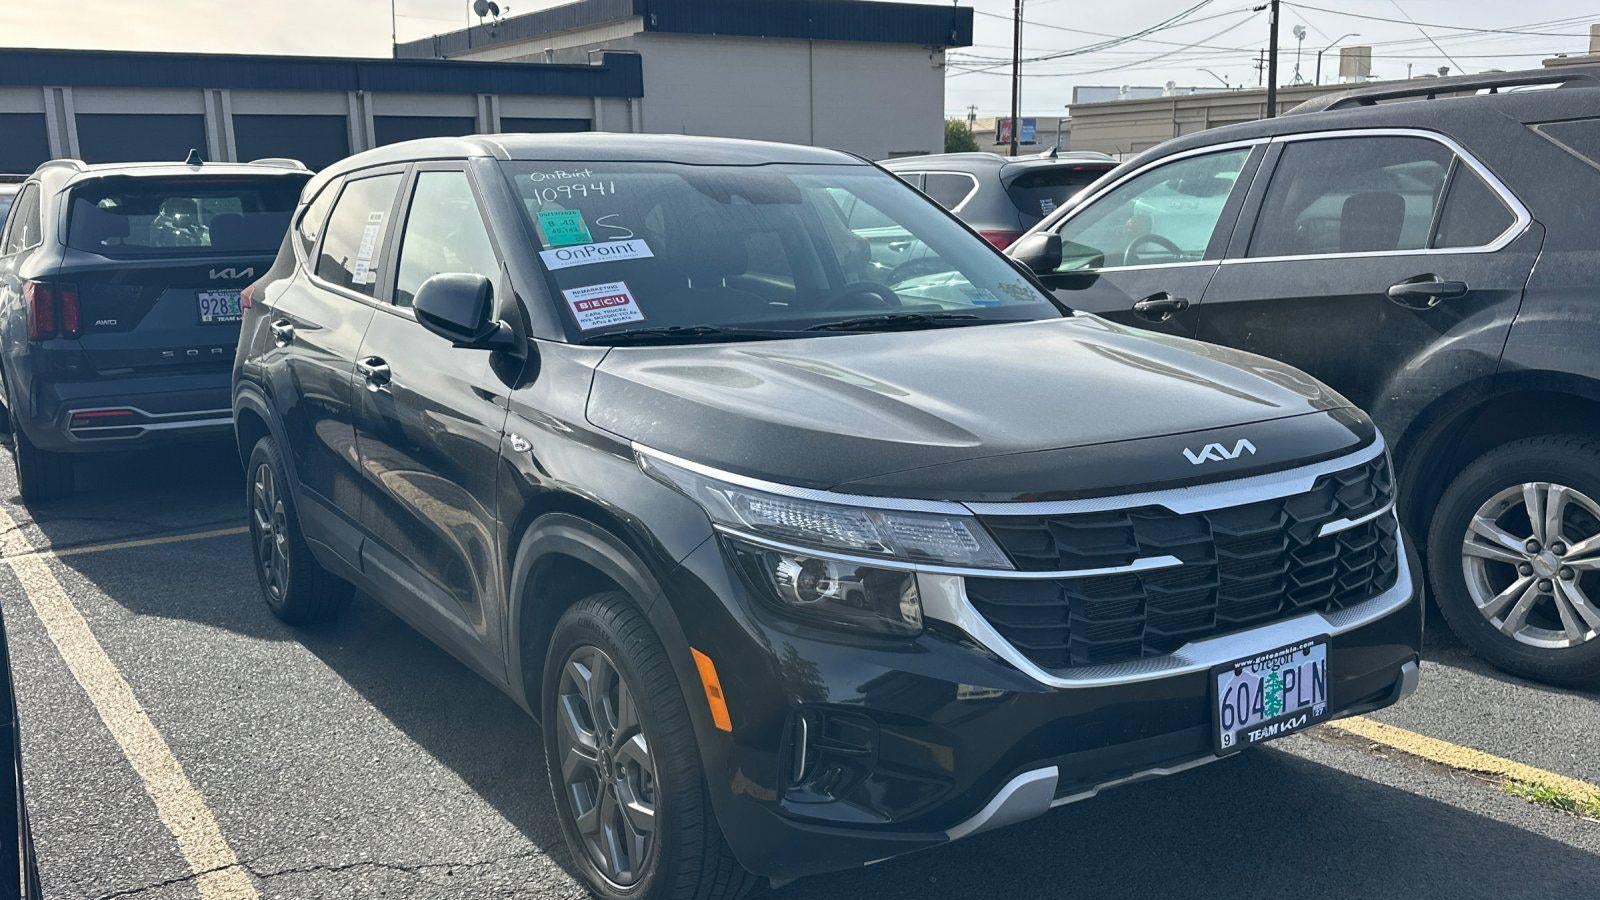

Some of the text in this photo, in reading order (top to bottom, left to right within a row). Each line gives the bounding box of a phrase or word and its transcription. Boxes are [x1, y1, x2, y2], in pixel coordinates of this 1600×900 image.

[530, 168, 593, 182] OnPoint
[534, 181, 615, 206] 109941
[596, 213, 634, 240] S
[555, 242, 637, 261] OnPoint
[209, 267, 254, 280] KIA
[572, 284, 618, 295] REMARKETING
[201, 298, 229, 316] 928
[1182, 438, 1257, 465] KIA
[1234, 640, 1315, 669] www.goteamkia.com
[1251, 655, 1294, 674] Oregon
[1221, 658, 1325, 731] 604 PLN
[1248, 713, 1307, 743] TEAM KIA
[1223, 734, 1231, 747] 9
